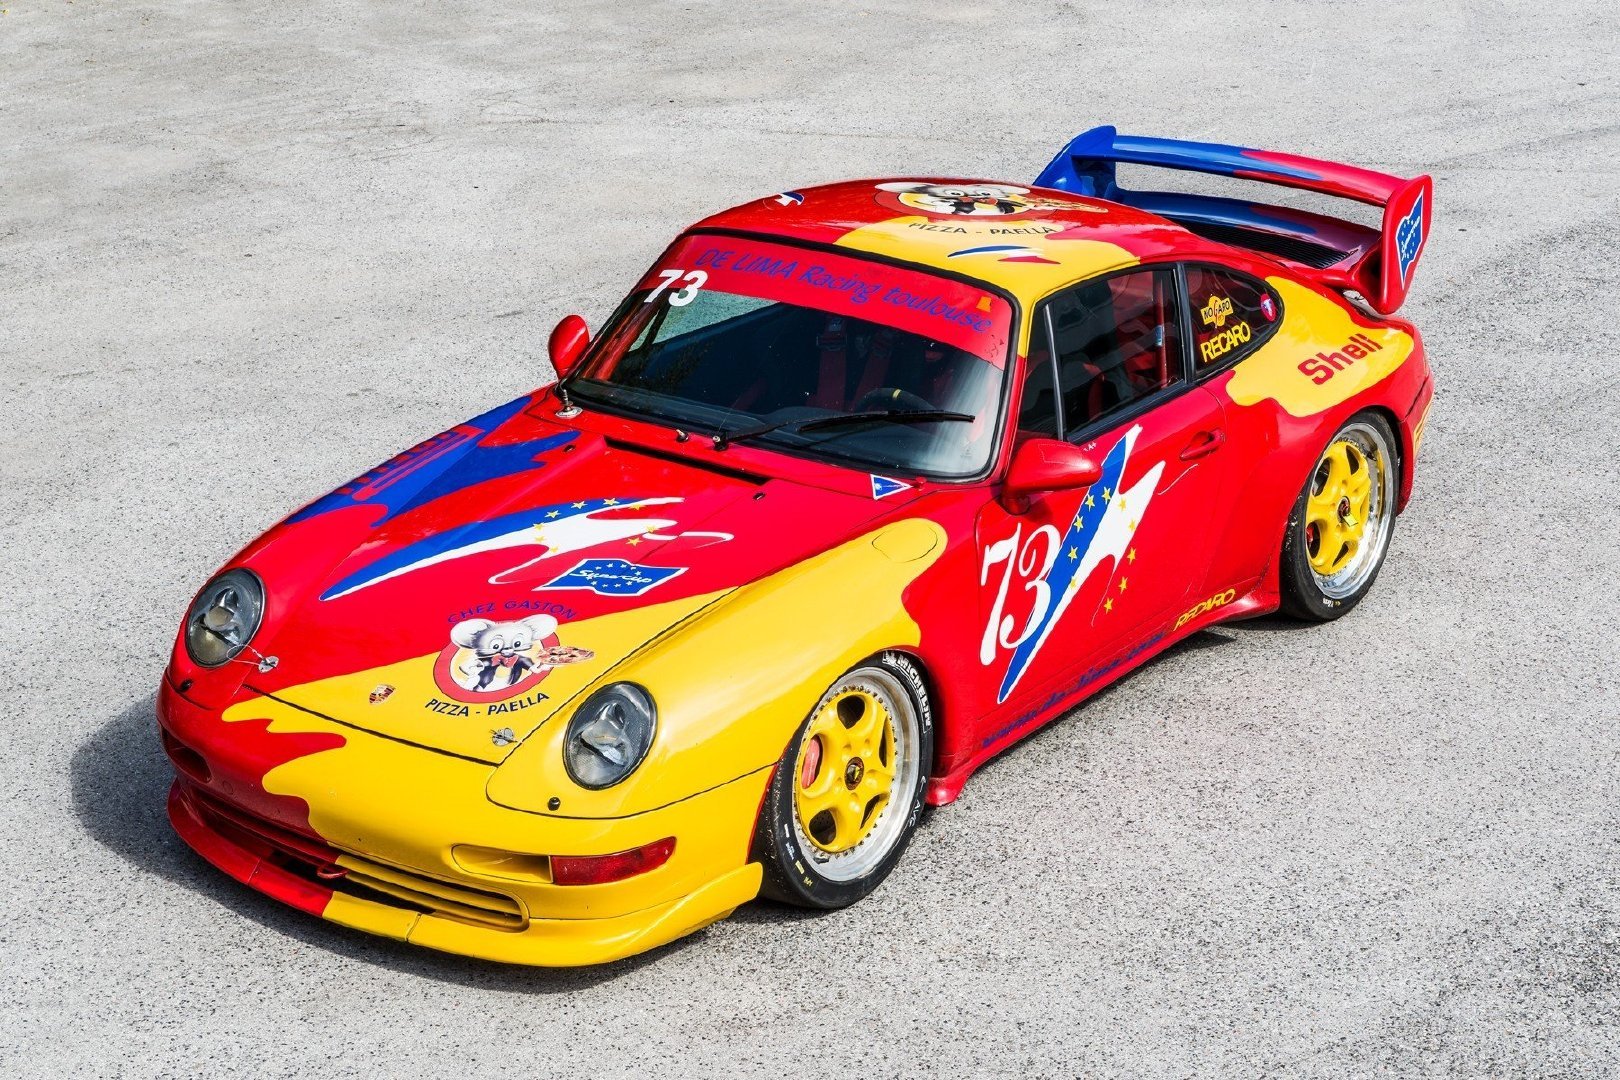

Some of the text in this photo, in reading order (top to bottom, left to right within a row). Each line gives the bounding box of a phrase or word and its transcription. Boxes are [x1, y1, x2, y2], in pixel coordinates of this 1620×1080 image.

[908, 222, 967, 234] PIZZA
[642, 268, 709, 308] 73
[694, 248, 993, 334] DE LIMA Racing toulouse
[1201, 321, 1251, 362] RECARO
[1297, 333, 1383, 386] Shell
[447, 599, 578, 624] CHEZ GASTON
[979, 522, 1062, 666] 73
[425, 698, 469, 717] PIZZA
[487, 692, 550, 716] PAELLA
[897, 654, 932, 727] MICHELIN
